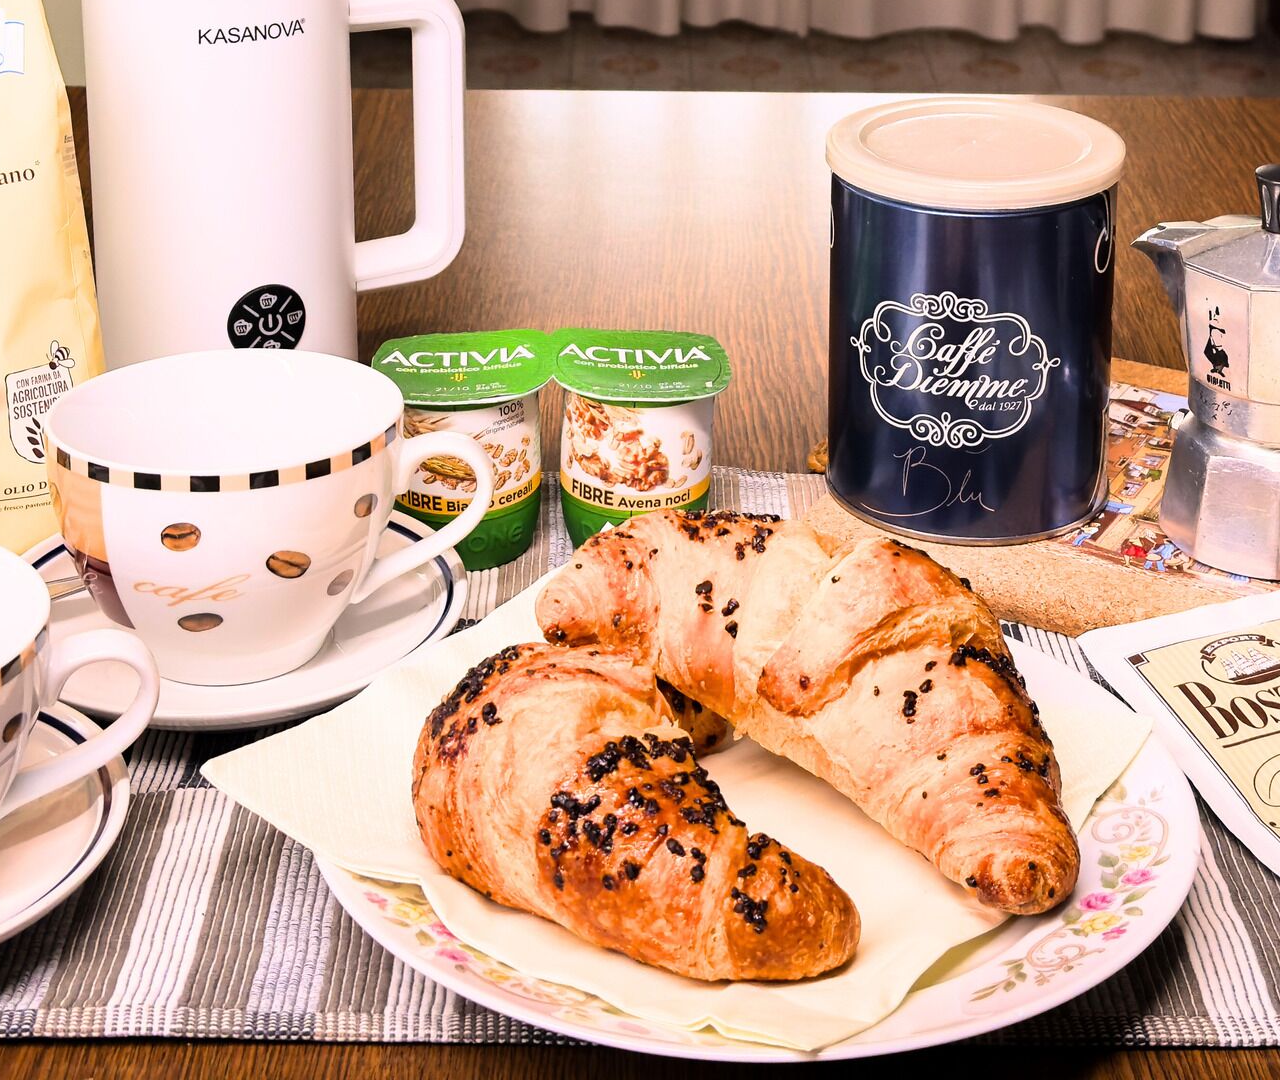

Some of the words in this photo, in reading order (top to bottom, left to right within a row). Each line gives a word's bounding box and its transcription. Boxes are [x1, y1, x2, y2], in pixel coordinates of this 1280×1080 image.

[198, 19, 305, 45] KASANOVA
[381, 344, 535, 367] ACTIVIA
[559, 343, 711, 363] ACTIVIA
[420, 366, 480, 374] probiotico
[483, 362, 522, 371] bifidus
[598, 362, 656, 370] probiotico
[16, 378, 30, 389] CON
[31, 373, 52, 385] FARINA
[53, 371, 62, 379] DA
[874, 353, 1028, 411] Diemme
[13, 380, 69, 404] AGRICOLTURA
[13, 396, 60, 420] SOSTENI
[498, 399, 524, 417] 100%
[978, 400, 996, 411] dal
[998, 400, 1022, 412] 1927
[4, 484, 35, 496] OLIO
[39, 481, 48, 490] D
[400, 489, 443, 512] FIBRE
[447, 499, 494, 513] Biao
[498, 482, 533, 506] cereali
[571, 480, 614, 507] FIBRE
[617, 496, 662, 509] Avena
[665, 489, 690, 505] noci
[3, 503, 24, 512] fresco
[25, 500, 52, 510] pastoriz
[133, 573, 251, 607] cafe
[1204, 633, 1260, 655] EXPORT
